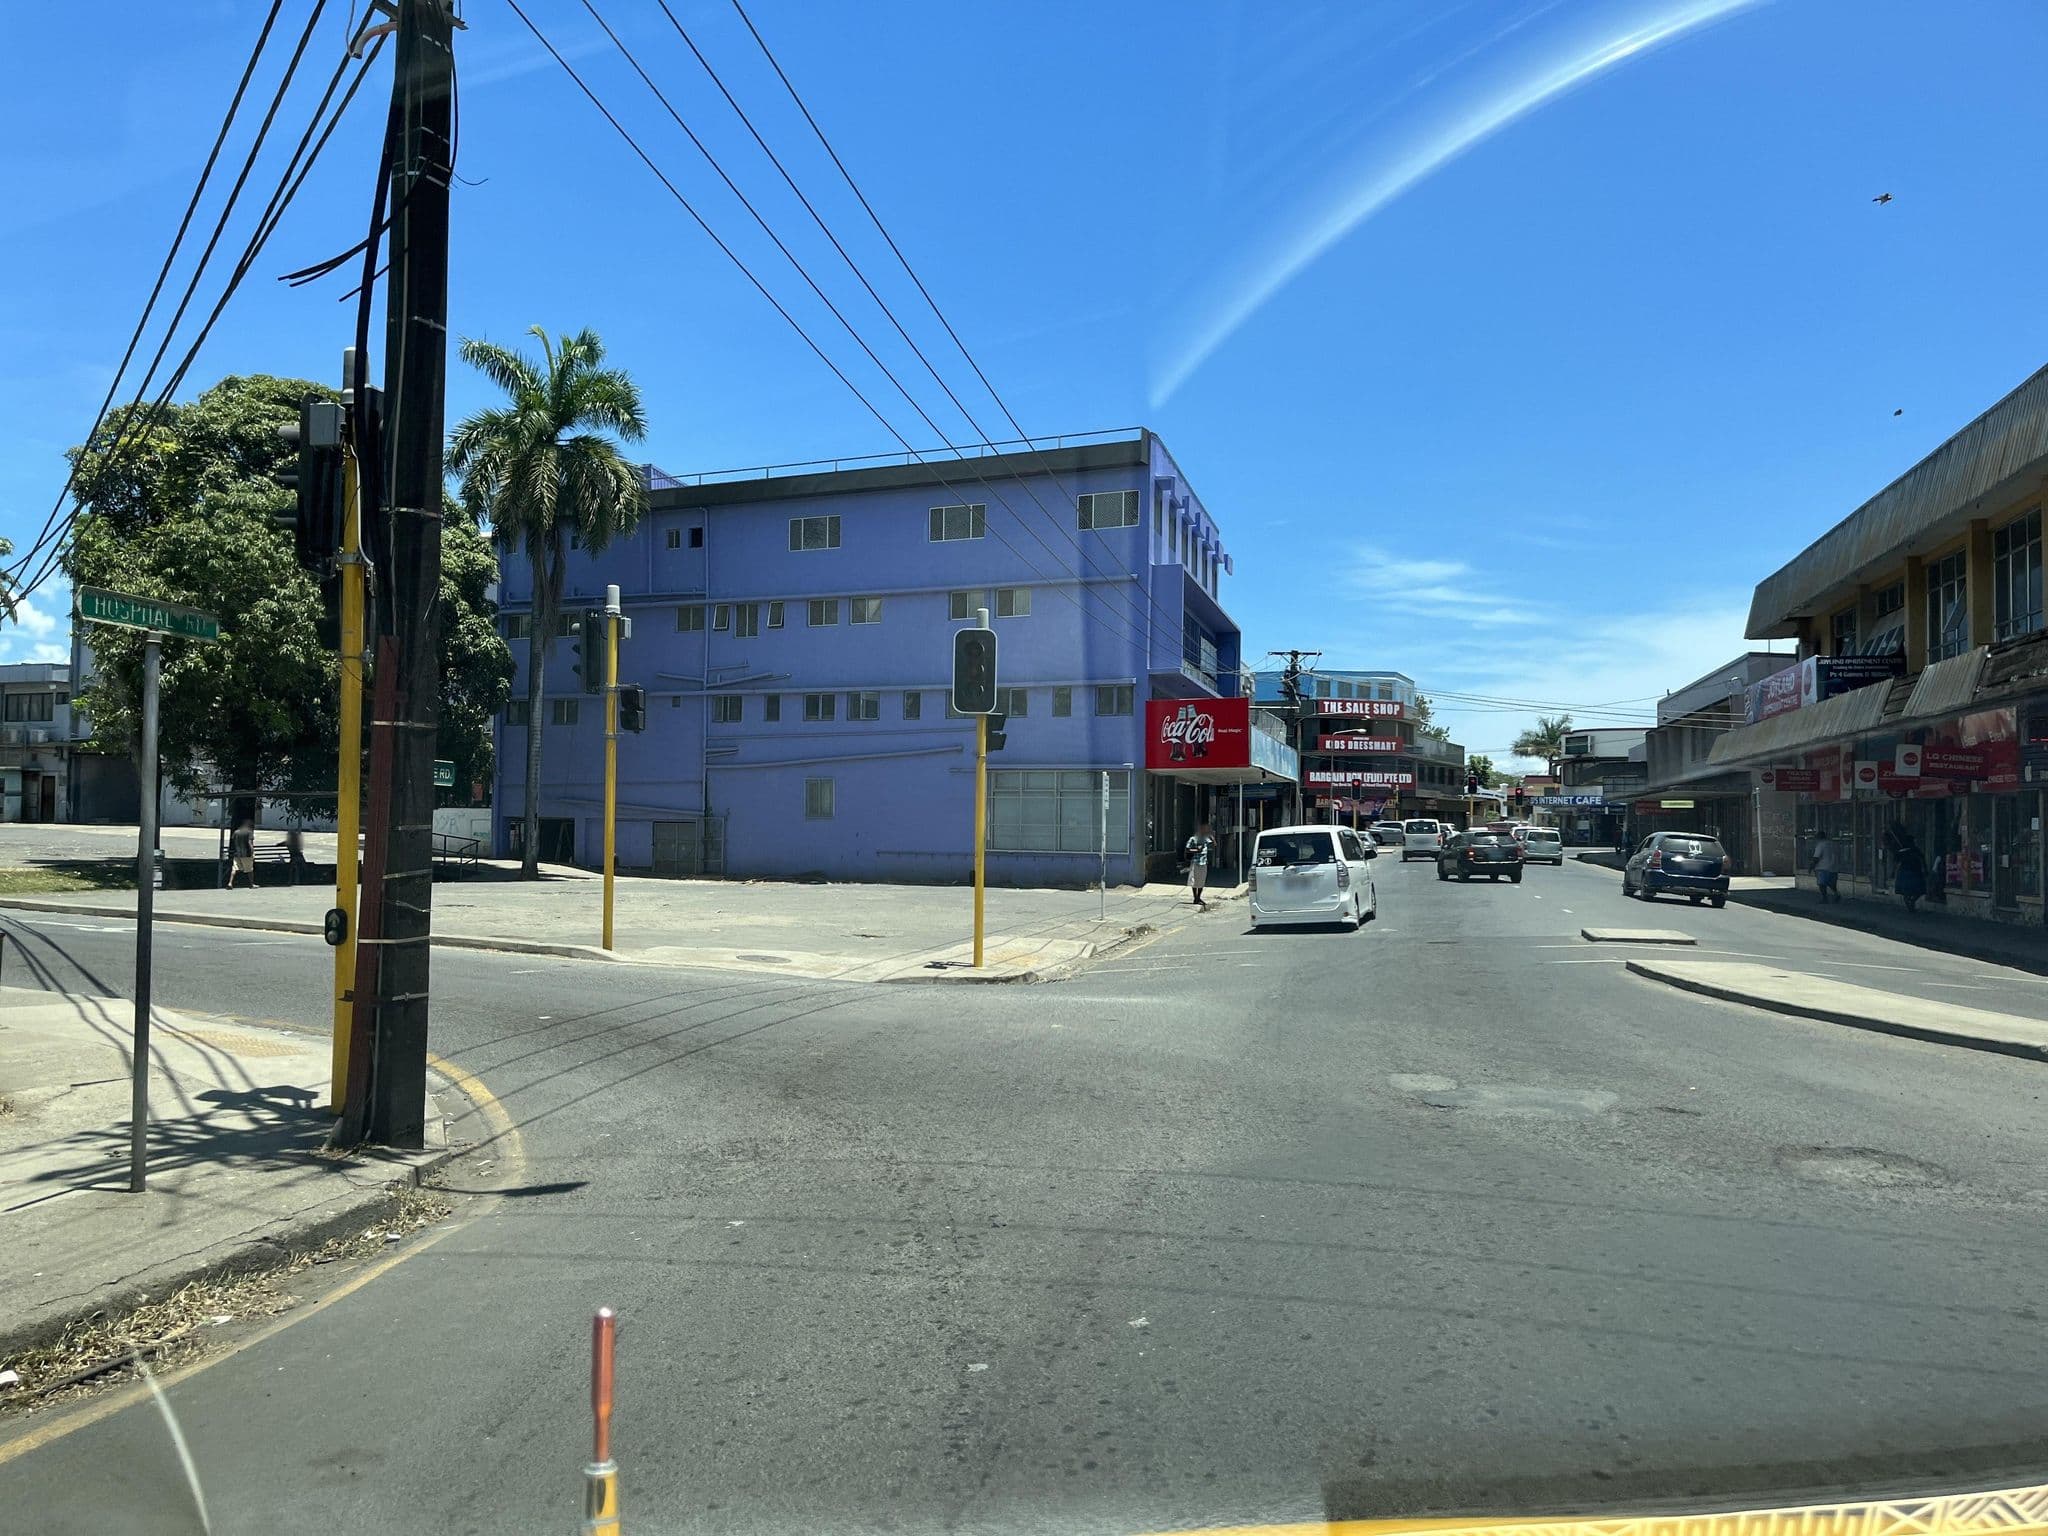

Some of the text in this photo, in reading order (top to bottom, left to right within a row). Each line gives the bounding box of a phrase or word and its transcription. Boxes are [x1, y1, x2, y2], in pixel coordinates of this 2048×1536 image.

[95, 597, 173, 628] HOSPITAL
[1323, 702, 1400, 715] THE SALE SHOP
[1161, 714, 1215, 743] Coca-Cola
[1325, 740, 1397, 751] KIDS DRESSMART
[1309, 772, 1345, 782] BARGAIN
[1384, 773, 1398, 783] PTE
[1398, 774, 1412, 784] LTD
[1539, 796, 1574, 806] INTERNET
[1576, 796, 1602, 805] CAFE
